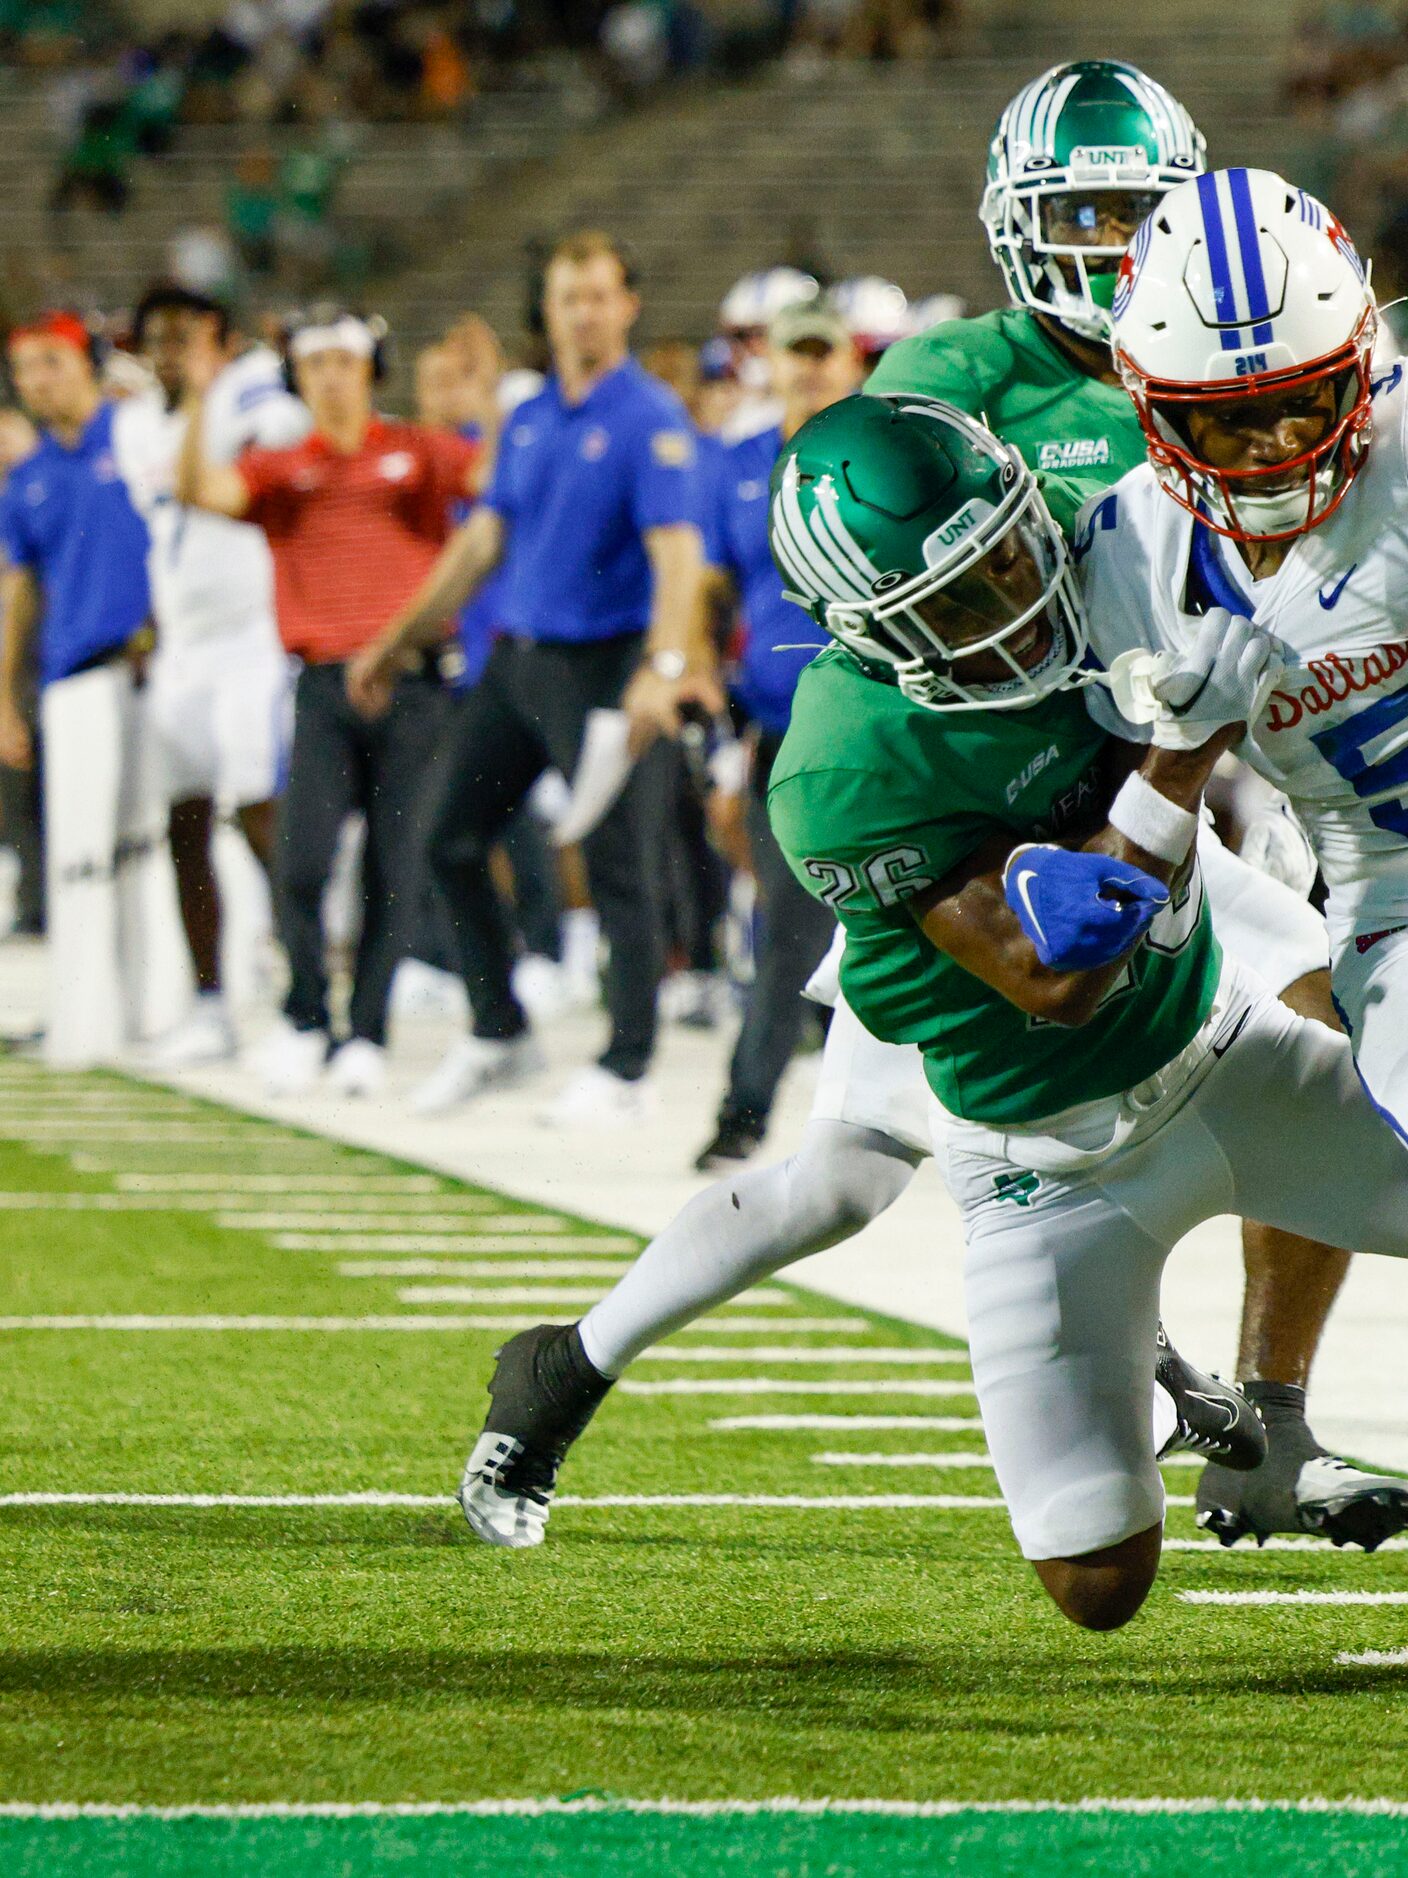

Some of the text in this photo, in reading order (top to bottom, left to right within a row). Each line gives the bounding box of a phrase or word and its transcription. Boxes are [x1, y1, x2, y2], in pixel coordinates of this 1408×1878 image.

[1088, 150, 1127, 165] UNT
[1234, 352, 1268, 377] 214
[937, 508, 976, 546] UNT
[802, 843, 934, 916] 26
